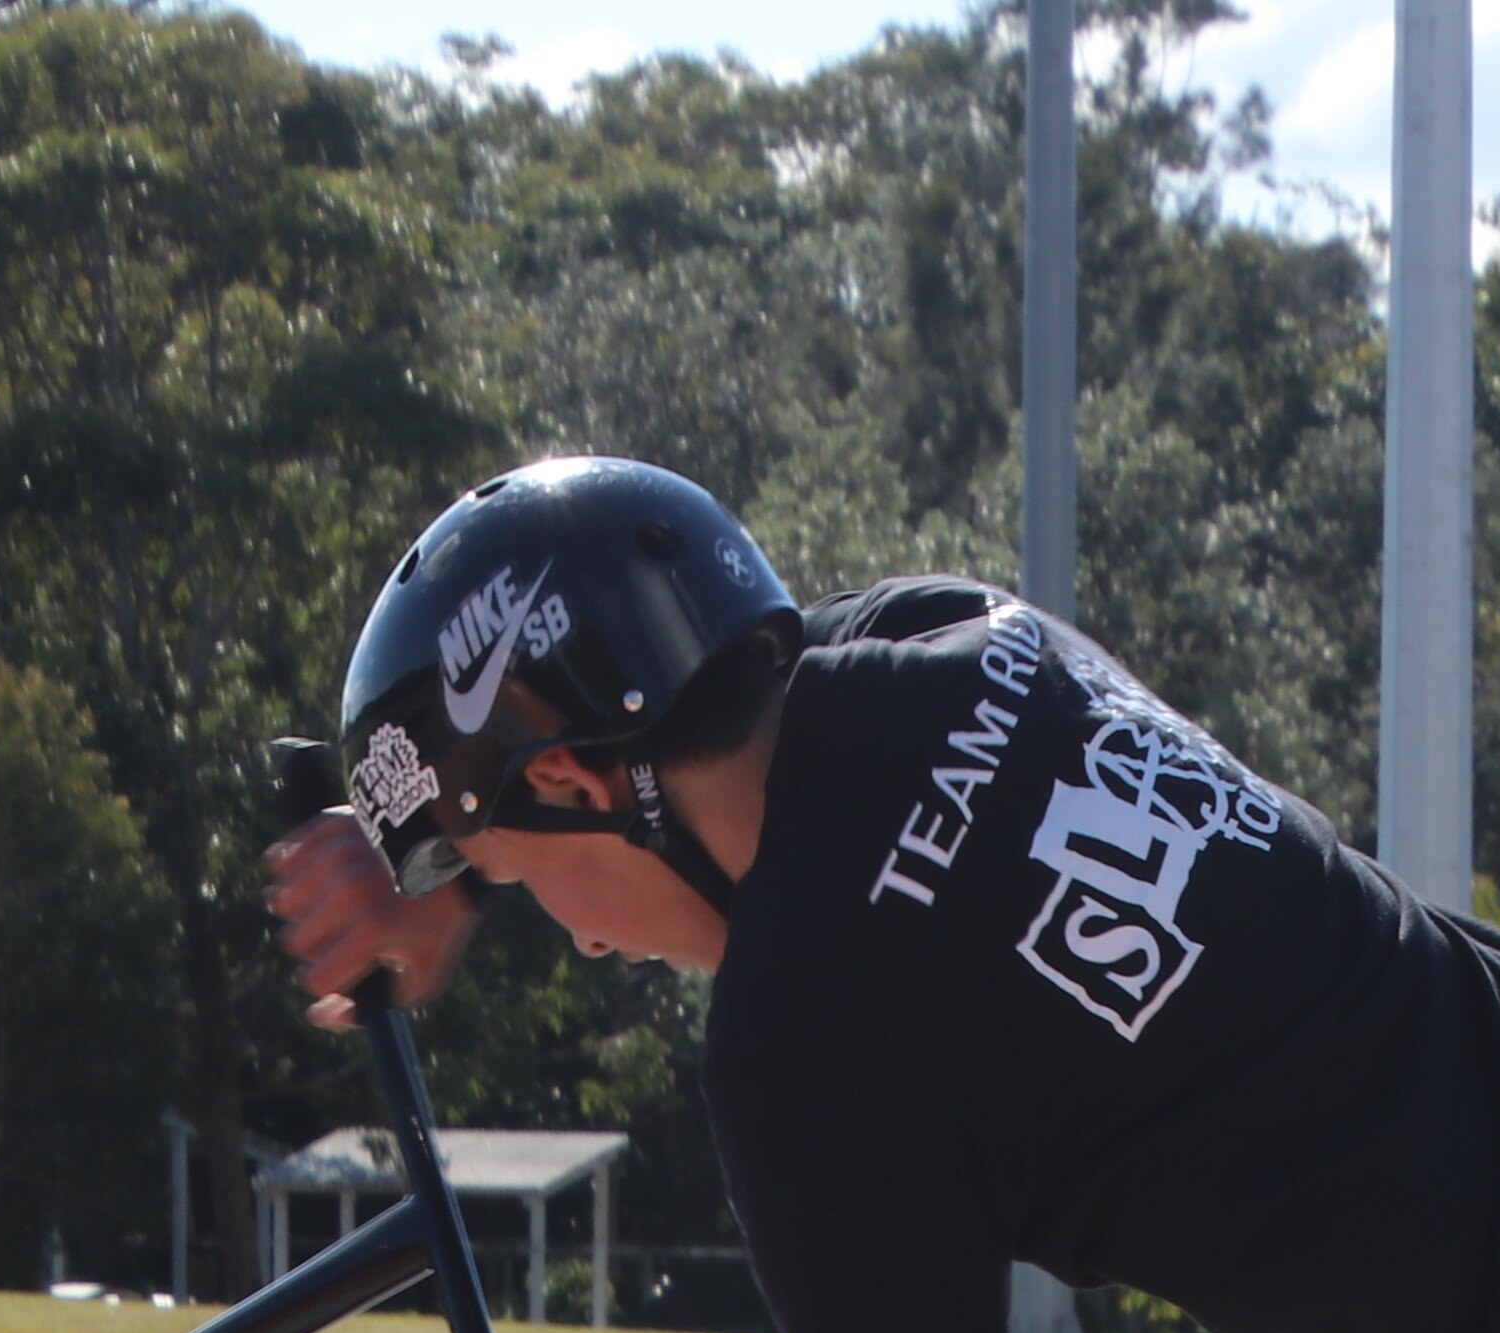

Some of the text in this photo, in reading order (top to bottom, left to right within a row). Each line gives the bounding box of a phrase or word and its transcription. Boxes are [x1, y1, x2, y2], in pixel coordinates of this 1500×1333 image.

[438, 565, 571, 685] NIKE SB
[868, 607, 1043, 907] TEAM RID
